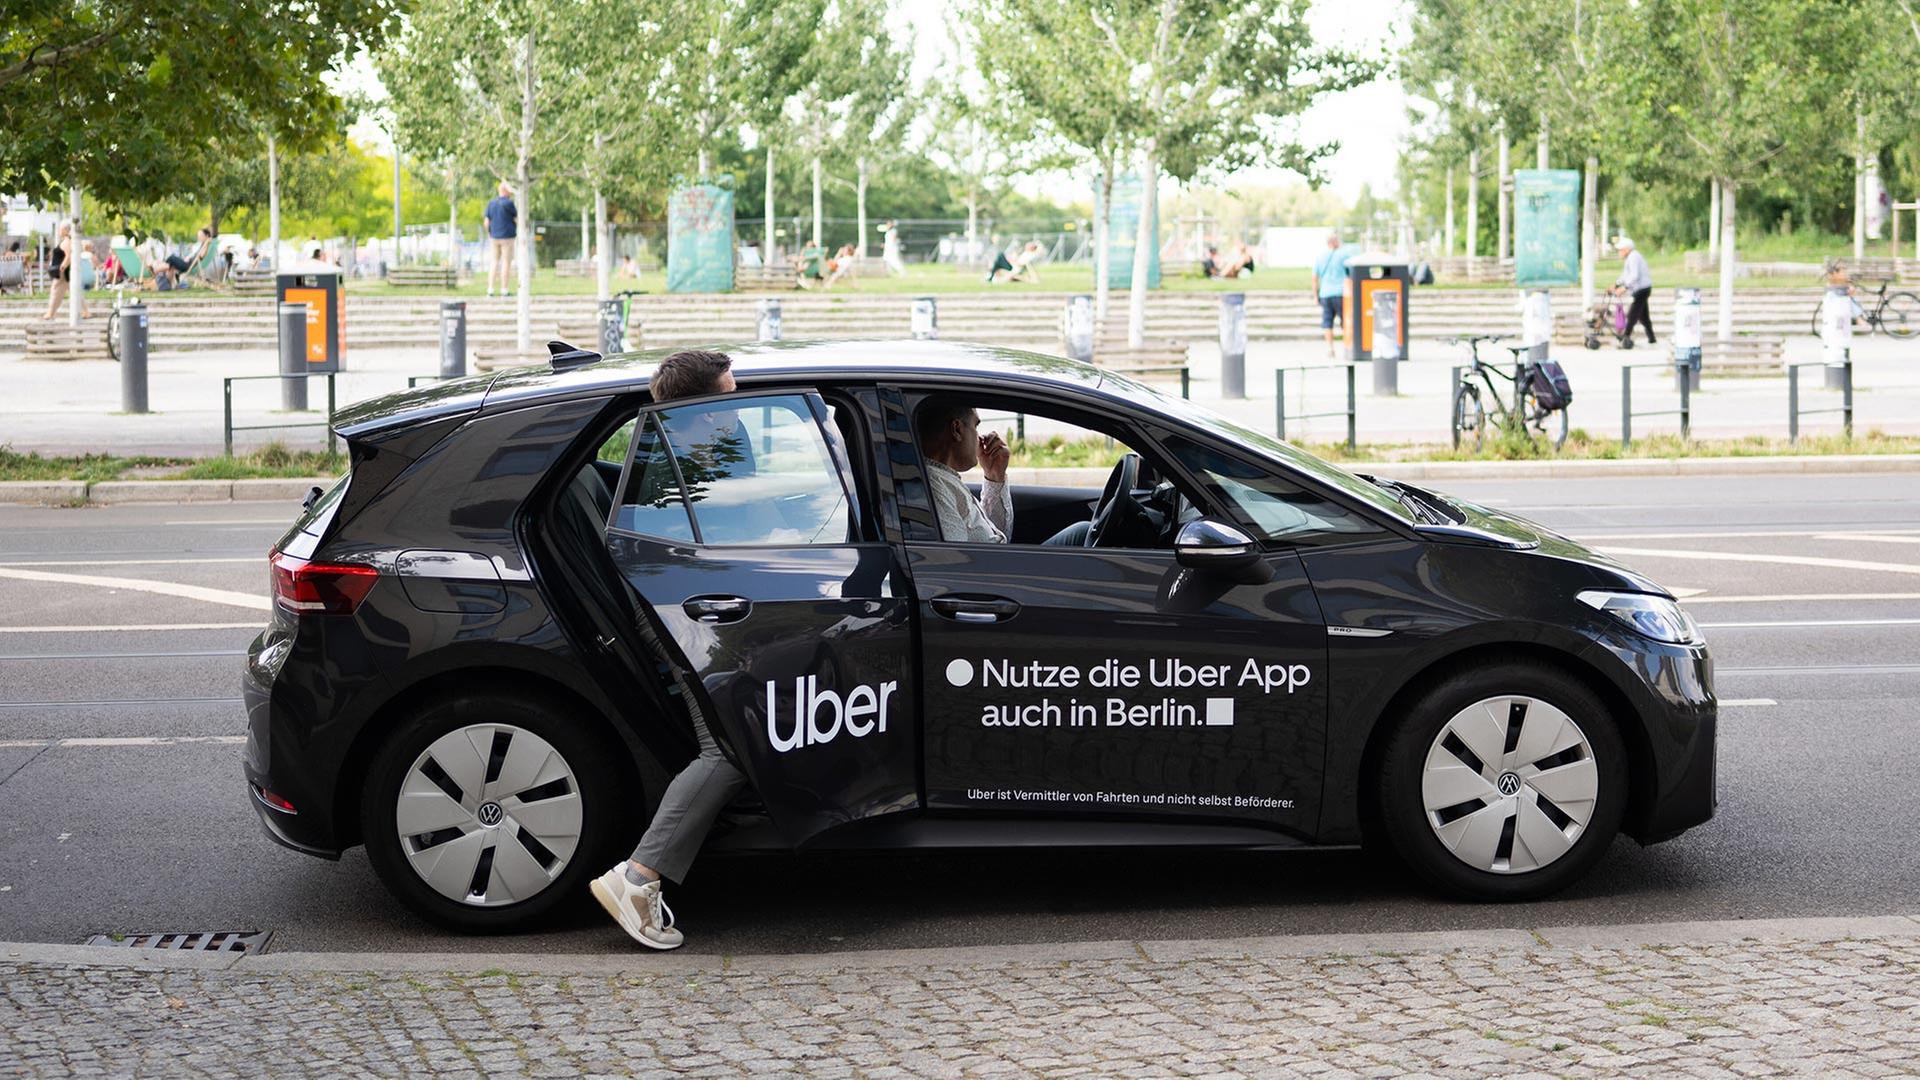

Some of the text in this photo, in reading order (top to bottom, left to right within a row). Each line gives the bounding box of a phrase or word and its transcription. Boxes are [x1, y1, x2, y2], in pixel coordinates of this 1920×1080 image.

[983, 657, 1311, 694] Nutze die Uber App
[766, 674, 897, 753] Uber
[981, 697, 1204, 727] auch in Berlin.
[967, 788, 1295, 809] Uber ist Vermittler von Fahrten und nicht selbst Beförderer.
